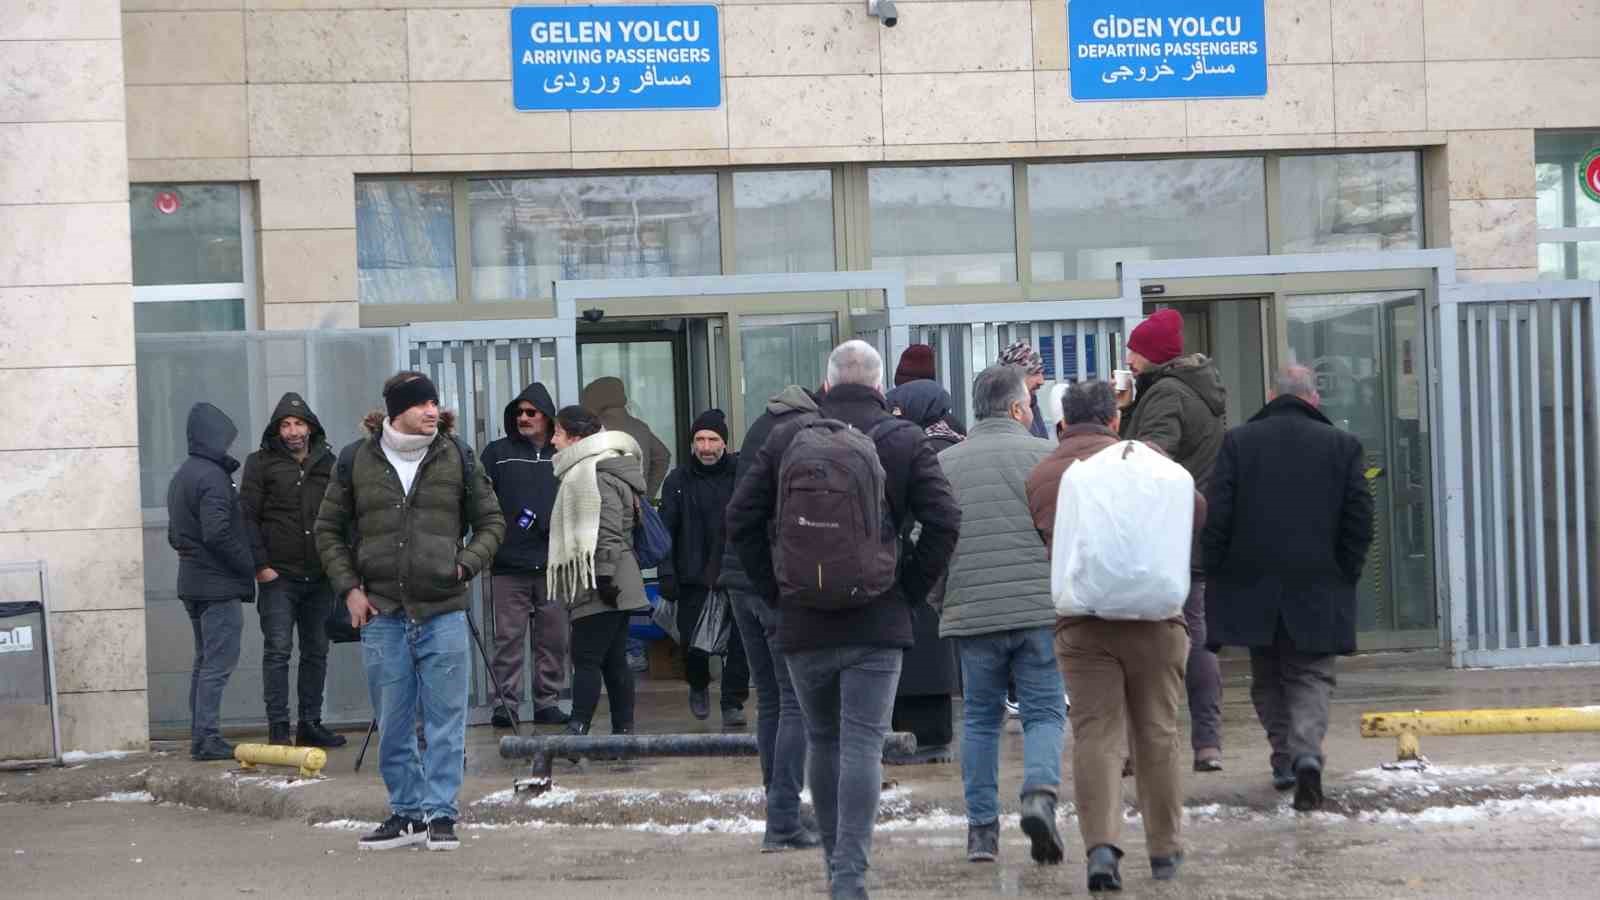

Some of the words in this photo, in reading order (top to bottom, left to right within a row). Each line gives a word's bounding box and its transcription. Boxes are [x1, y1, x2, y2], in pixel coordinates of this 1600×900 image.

[530, 21, 612, 44] GELEN
[617, 20, 700, 43] YOLCU
[1092, 14, 1163, 39] GİDEN
[1168, 16, 1241, 37] YOLCU
[522, 49, 602, 65] ARRIVING
[606, 47, 711, 64] PASSENGERS
[1078, 43, 1161, 58] DEPARTING
[1165, 41, 1258, 56] PASSENGERS
[630, 65, 692, 93] مسافر
[1183, 56, 1236, 80] مسافر
